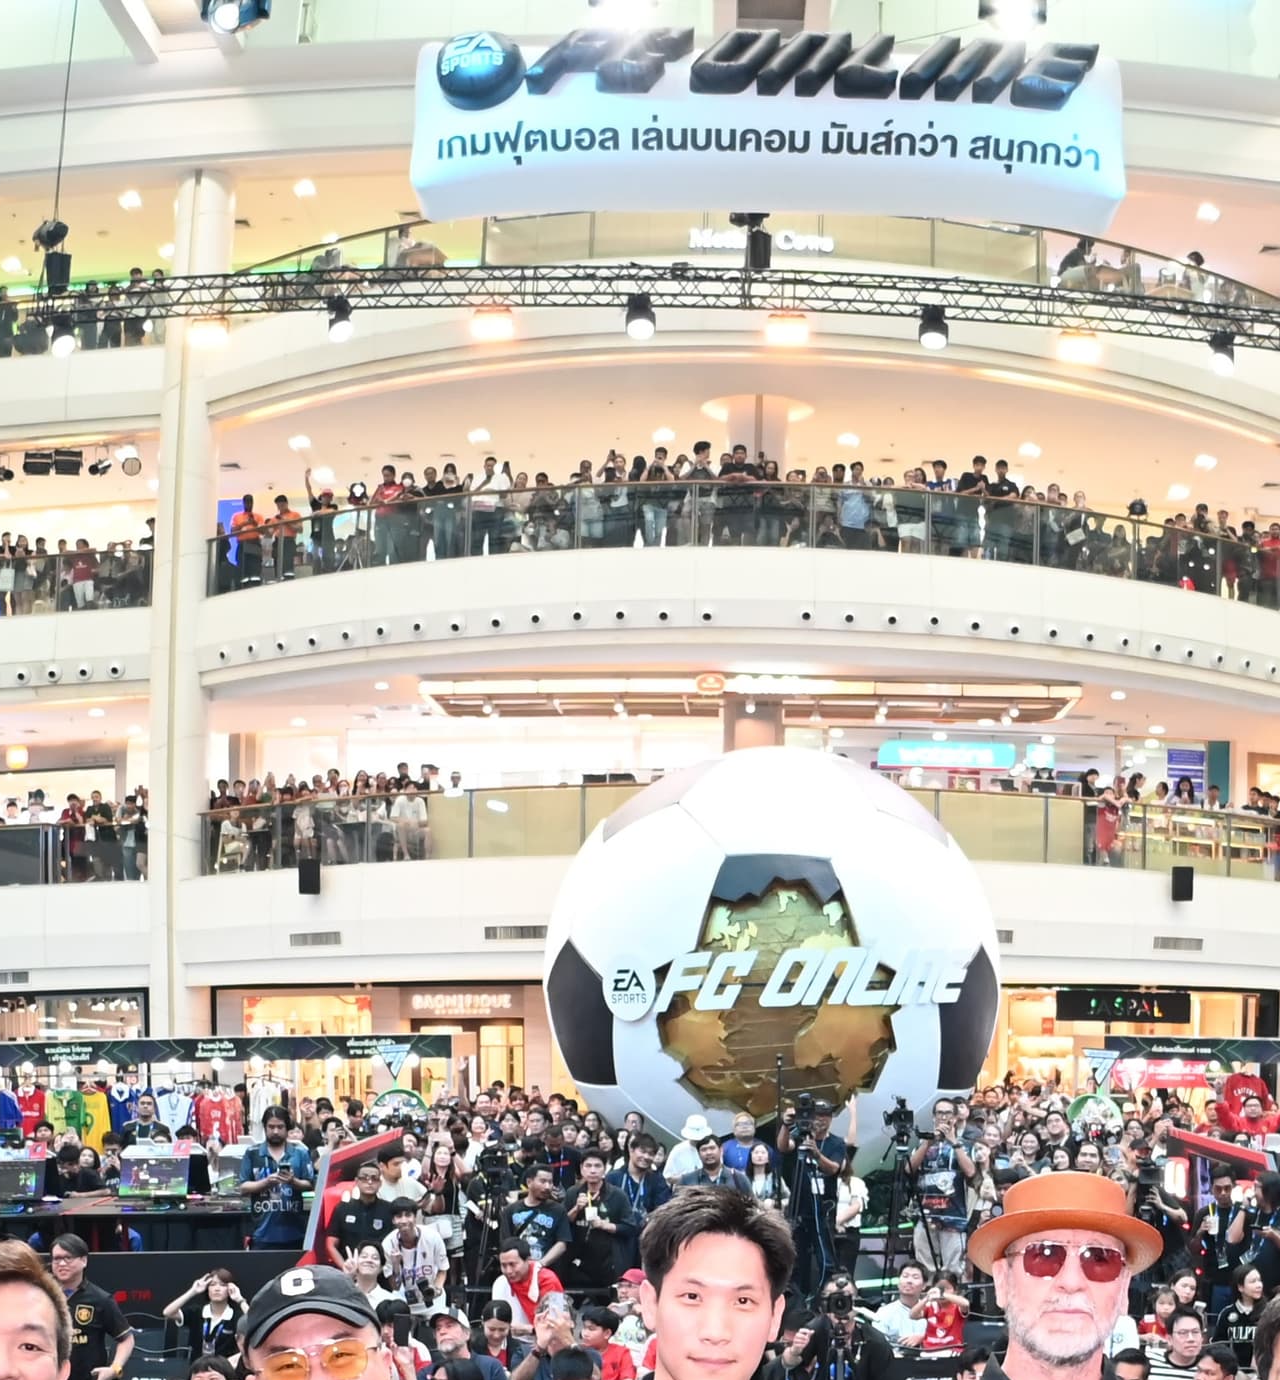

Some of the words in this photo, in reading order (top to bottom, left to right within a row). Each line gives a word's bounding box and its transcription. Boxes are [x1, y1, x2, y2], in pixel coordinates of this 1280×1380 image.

[441, 51, 506, 76] SPORTS
[689, 29, 1099, 111] ONLINE
[437, 119, 620, 166] เกมฟุตบอล
[631, 114, 810, 153] เล่นบนคอม
[821, 119, 958, 158] มันส์กว่า
[969, 133, 1100, 174] สนุกกว่า
[612, 968, 646, 992] EA
[656, 951, 758, 1014] FC
[758, 946, 968, 1008] ONLINE
[610, 993, 648, 1005] SPORTS
[1087, 998, 1164, 1018] JASPAL
[253, 1199, 300, 1213] GODLIKE
